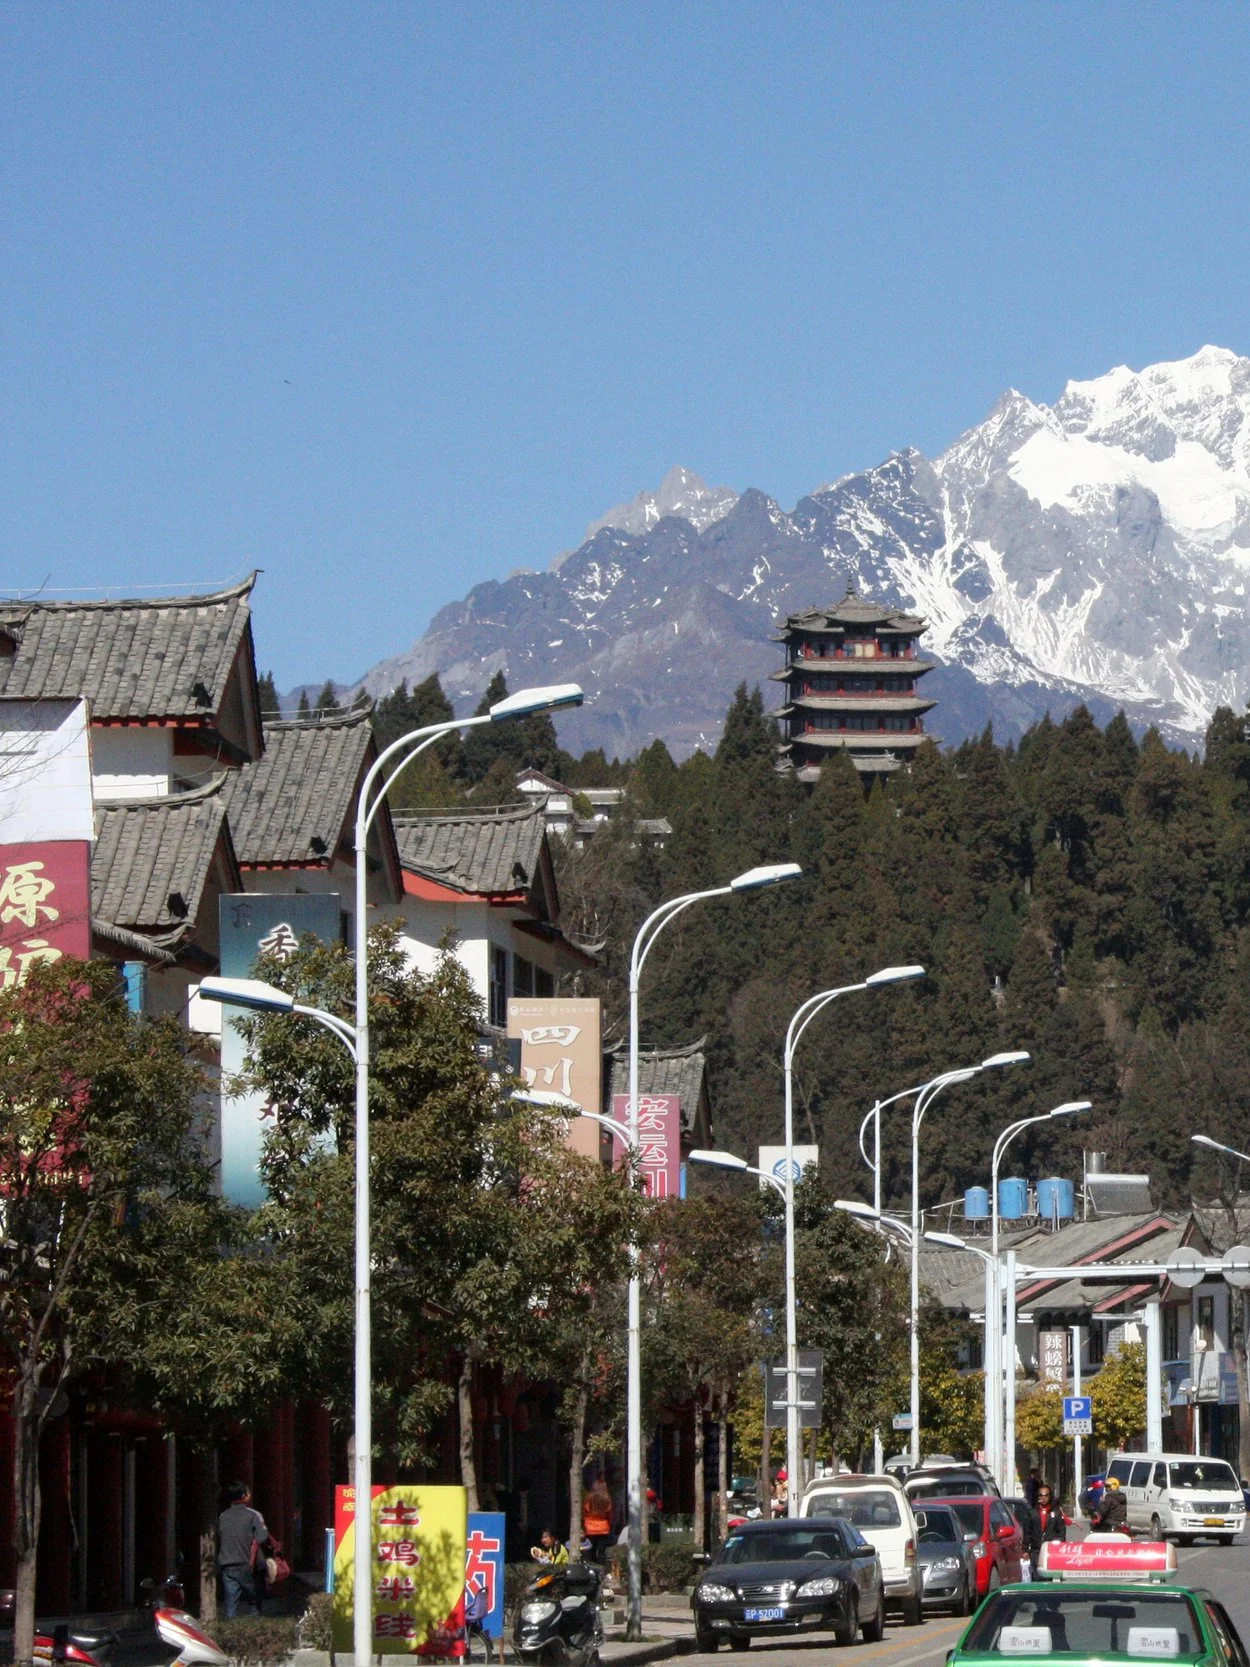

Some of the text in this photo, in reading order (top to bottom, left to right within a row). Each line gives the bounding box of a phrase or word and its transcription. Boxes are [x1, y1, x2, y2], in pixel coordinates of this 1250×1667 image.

[1071, 1401, 1084, 1417] P
[375, 1500, 420, 1639] 土鸡米线
